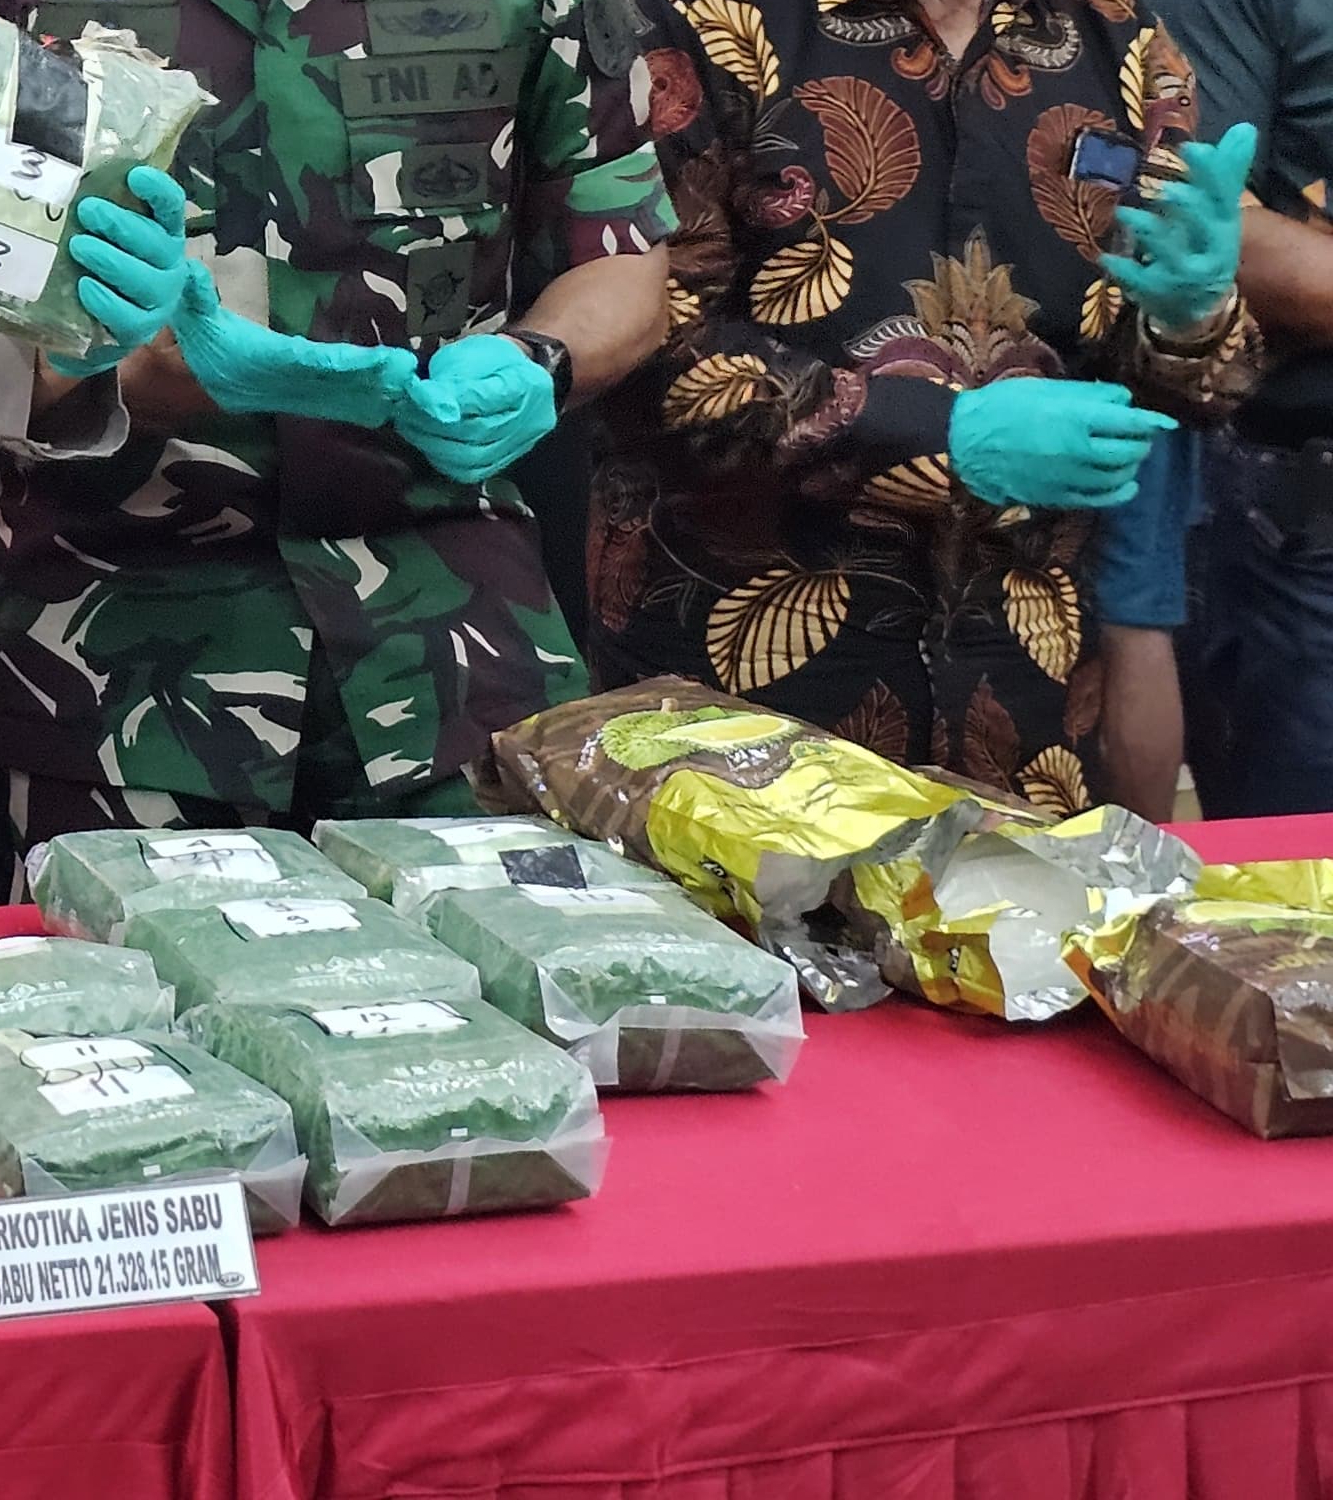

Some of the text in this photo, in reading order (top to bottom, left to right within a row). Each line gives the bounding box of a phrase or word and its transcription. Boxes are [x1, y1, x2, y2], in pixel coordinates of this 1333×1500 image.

[363, 64, 431, 104] TNI
[11, 148, 48, 180] 3
[97, 1199, 160, 1242] JENIS
[163, 1192, 223, 1234] SABU
[37, 1256, 93, 1302] NETTO
[94, 1248, 171, 1296] 21.328.15
[173, 1243, 223, 1288] GRAM
